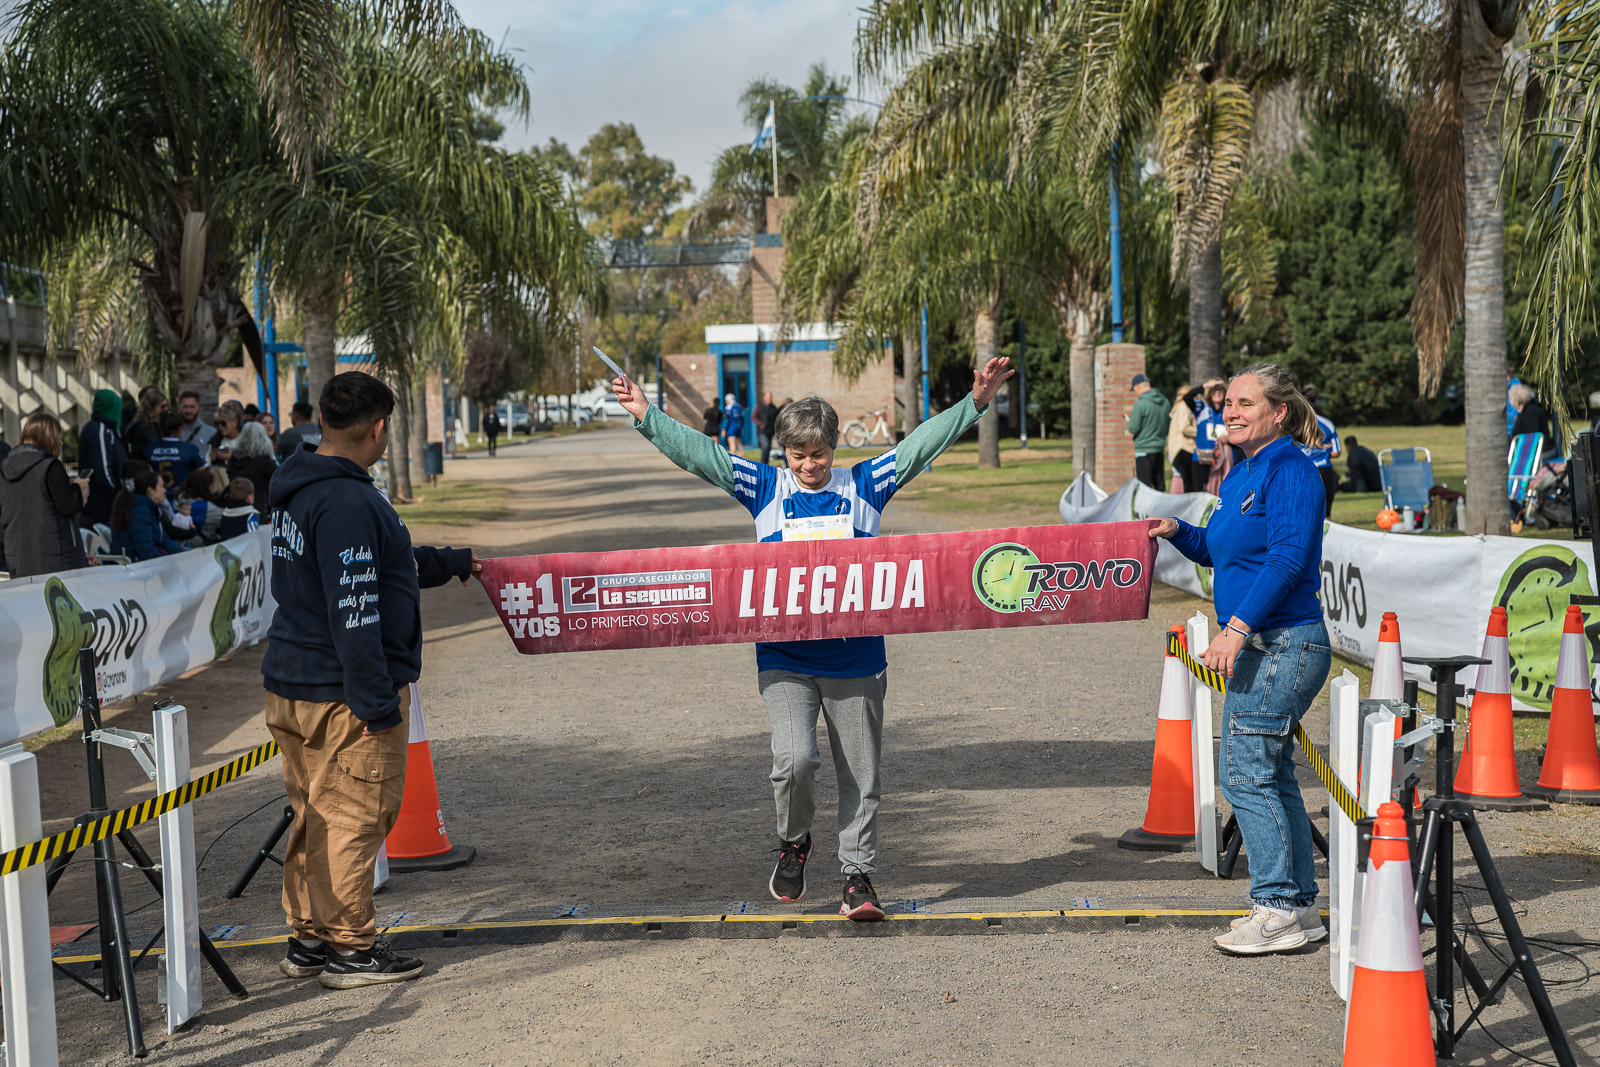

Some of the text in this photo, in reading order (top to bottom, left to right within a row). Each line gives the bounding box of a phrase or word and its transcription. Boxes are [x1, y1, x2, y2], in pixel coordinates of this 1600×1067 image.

[339, 547, 354, 566] El
[339, 570, 351, 586] de
[602, 573, 706, 586] GRUPO ASEGURADOR
[1023, 558, 1142, 593] RONO
[500, 573, 559, 616] #1
[603, 585, 707, 606] La segunda
[738, 559, 925, 618] LLEGADA
[1319, 560, 1367, 629] ONO
[1020, 594, 1071, 612] RAV
[345, 612, 360, 629] del
[509, 616, 560, 639] VOS
[568, 610, 710, 631] LO PRIMERO SOS VOS
